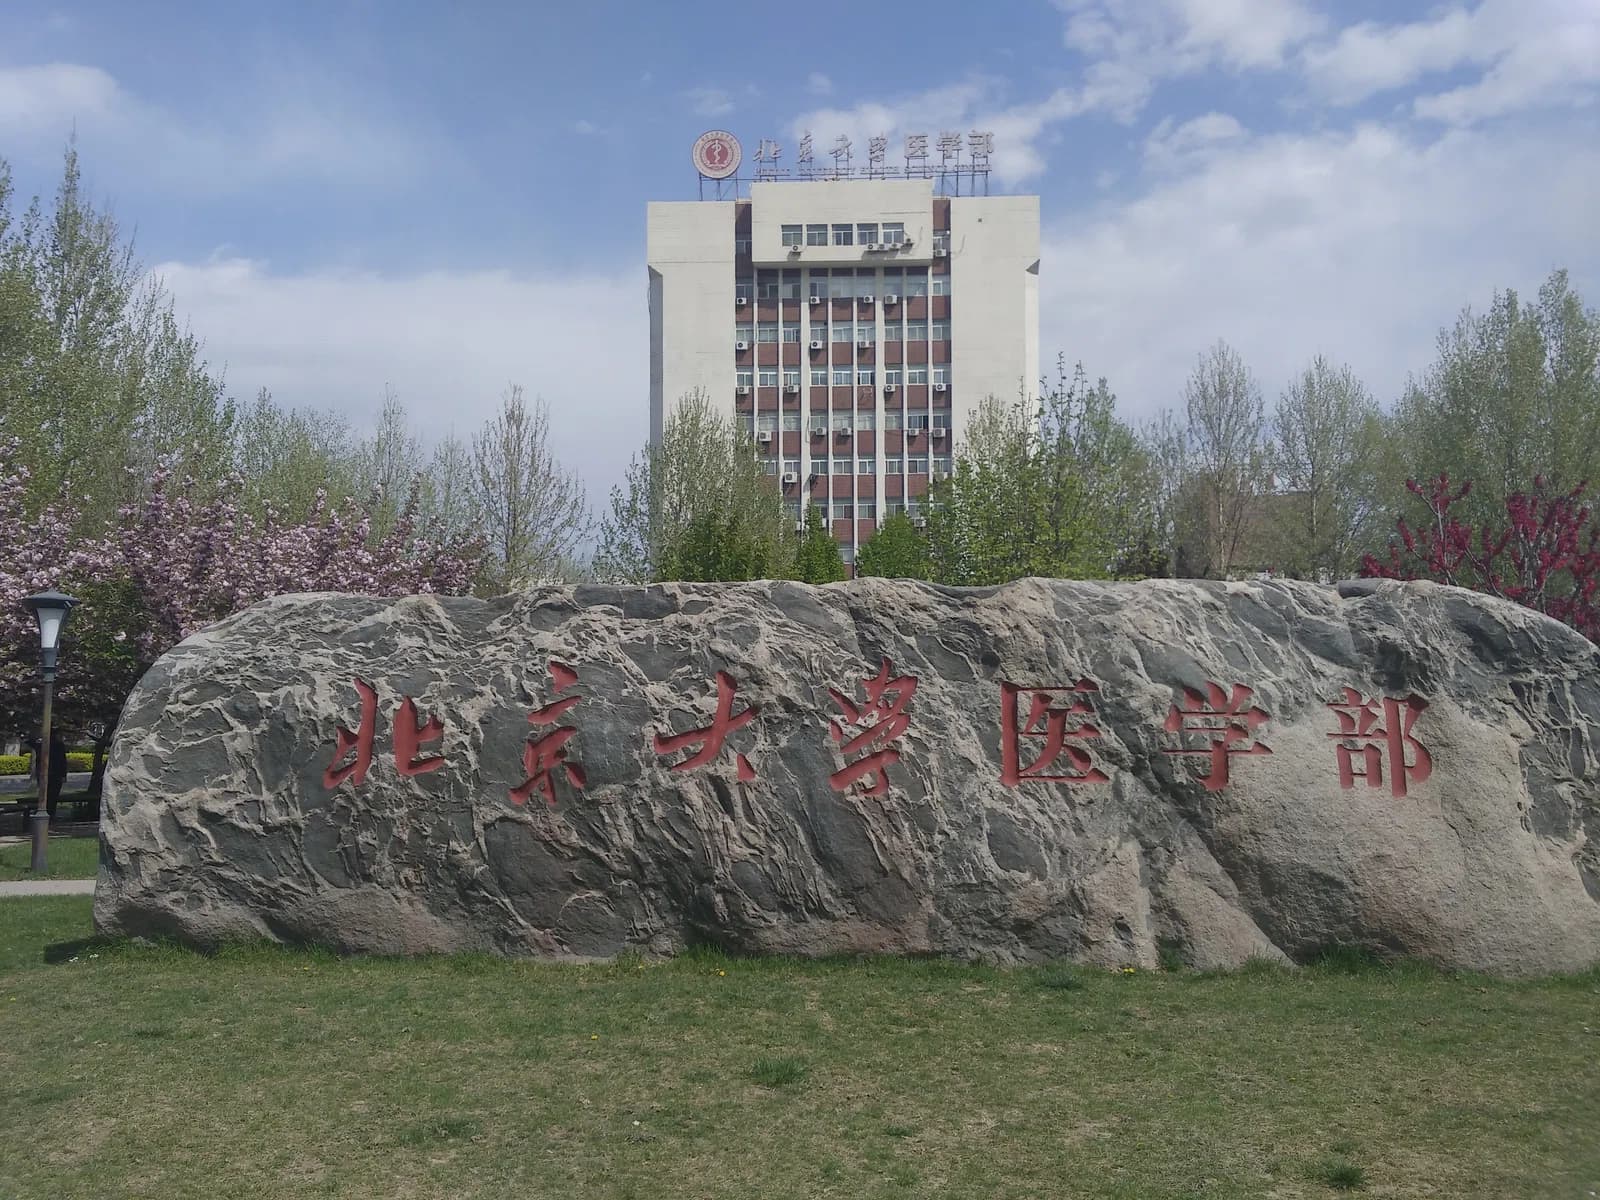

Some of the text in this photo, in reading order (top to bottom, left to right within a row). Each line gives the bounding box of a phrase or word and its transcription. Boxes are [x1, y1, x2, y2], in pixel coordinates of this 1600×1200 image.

[323, 658, 1433, 804] 北京大学医学部
